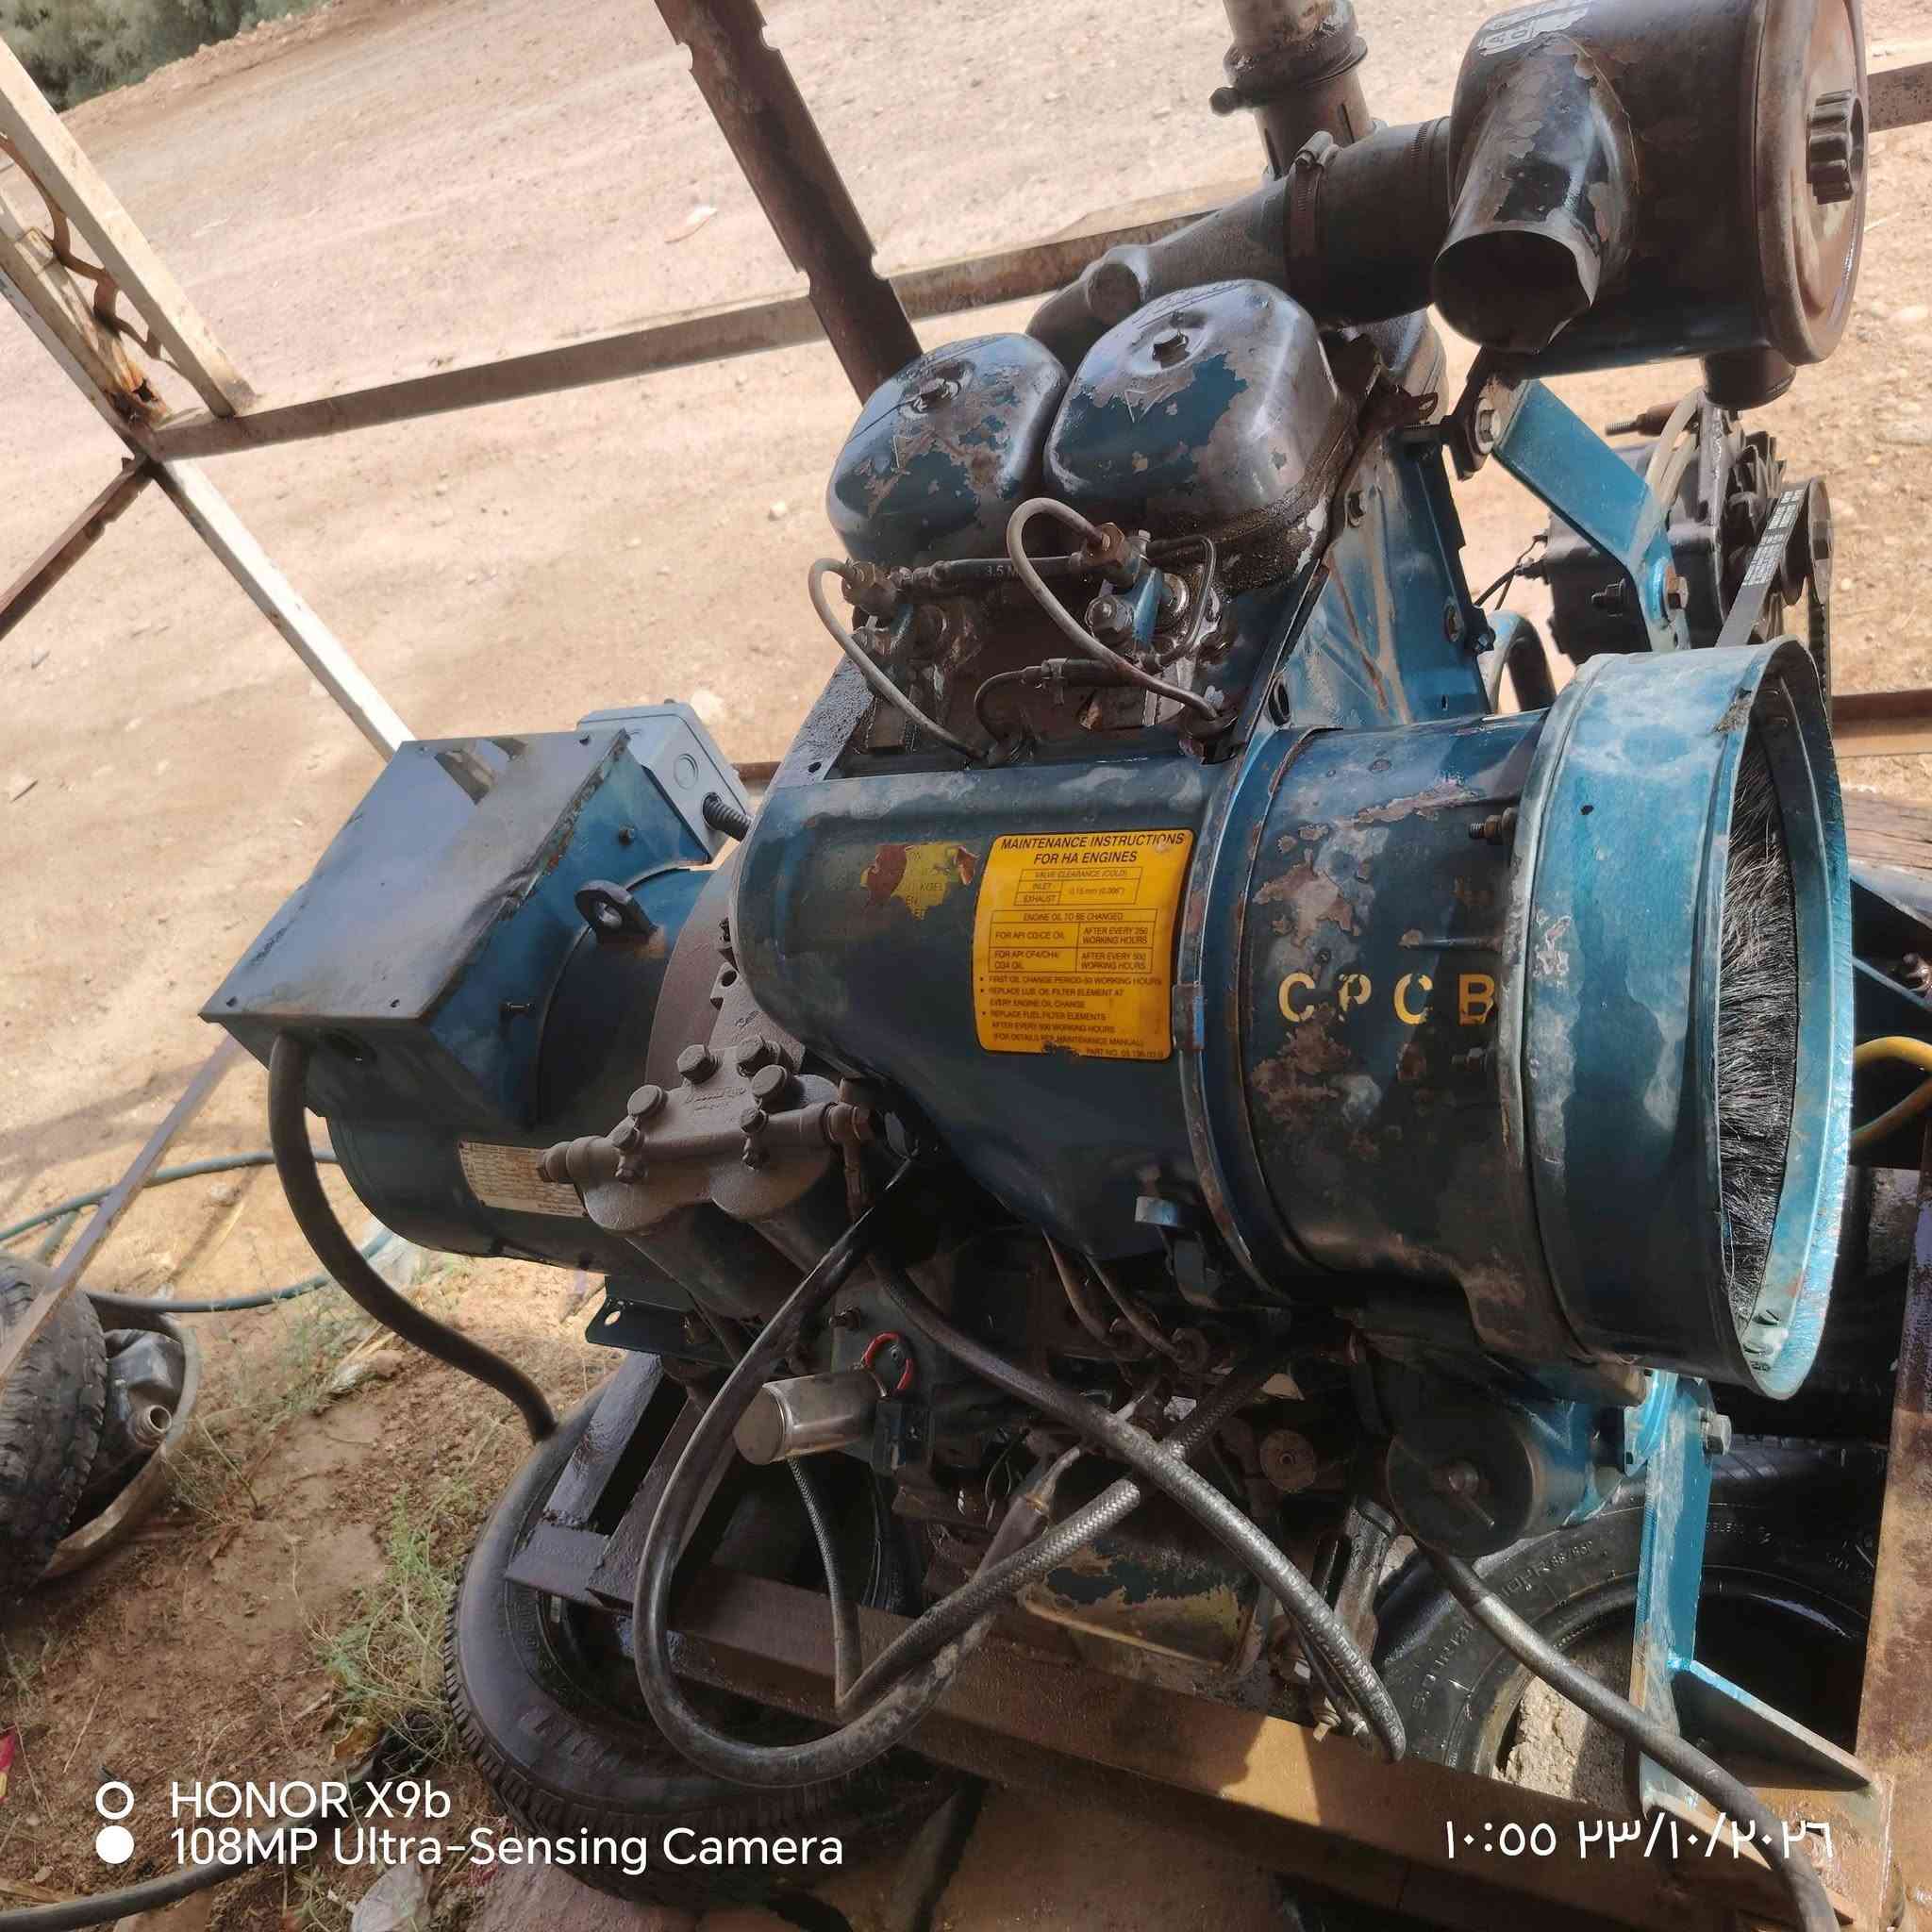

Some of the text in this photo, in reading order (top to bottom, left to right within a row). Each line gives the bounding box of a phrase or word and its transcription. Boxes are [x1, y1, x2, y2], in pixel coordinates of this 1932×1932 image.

[1001, 834, 1184, 849] MAINTENANCE INSTRUCTIONS
[1034, 852, 1137, 865] FOR HA ENGINES
[1024, 894, 1056, 903] EXHAUST
[1075, 912, 1085, 921] BE
[1087, 912, 1123, 921] CHANGED
[1084, 927, 1104, 936] AFTER
[1082, 936, 1148, 944] WORKING HOURS
[1081, 961, 1146, 970] WORKING HOURS
[1094, 976, 1131, 985] WORKING
[1077, 989, 1113, 997] ELEMENT
[1067, 1012, 1107, 1021] ELEMENTS
